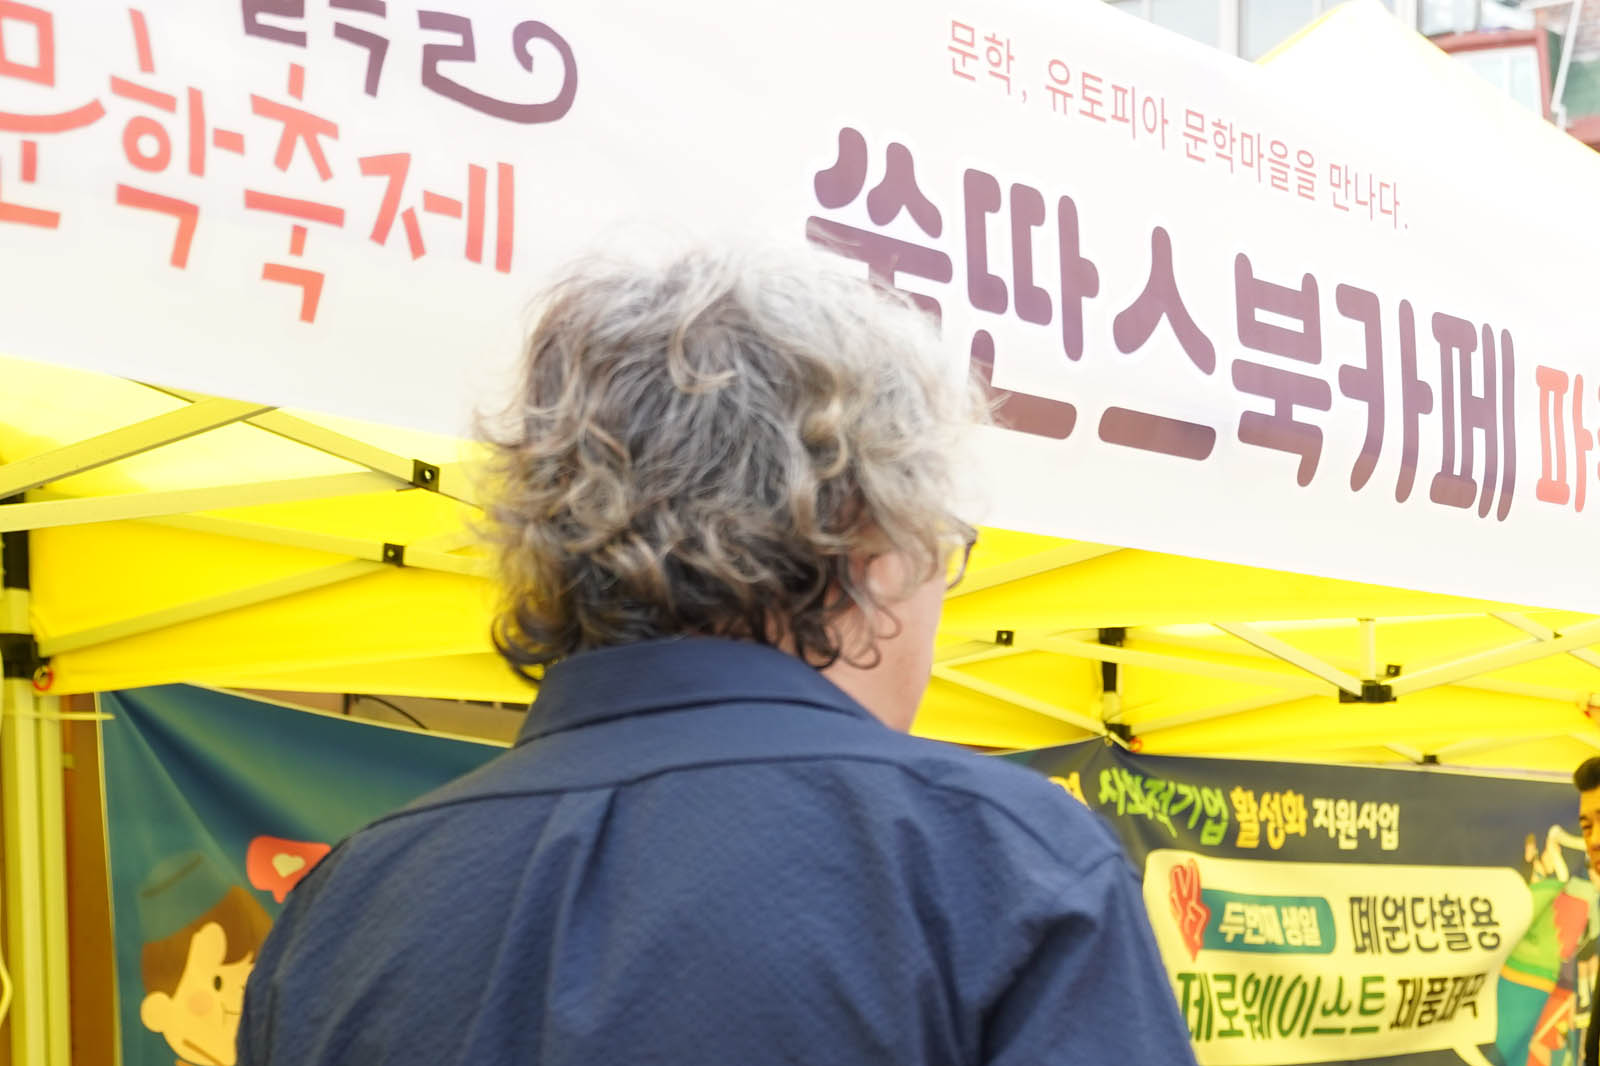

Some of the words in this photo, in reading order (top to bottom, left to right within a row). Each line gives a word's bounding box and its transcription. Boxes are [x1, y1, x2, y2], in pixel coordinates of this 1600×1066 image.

[947, 19, 1027, 103] 문학,
[1045, 58, 1169, 150] 유토피아
[1182, 107, 1317, 201] 문학마을을
[1329, 161, 1409, 230] 만나다.
[1230, 786, 1308, 850] 활성화
[1313, 798, 1400, 851] 지원사업
[1177, 972, 1386, 1041] 제로웨이스트
